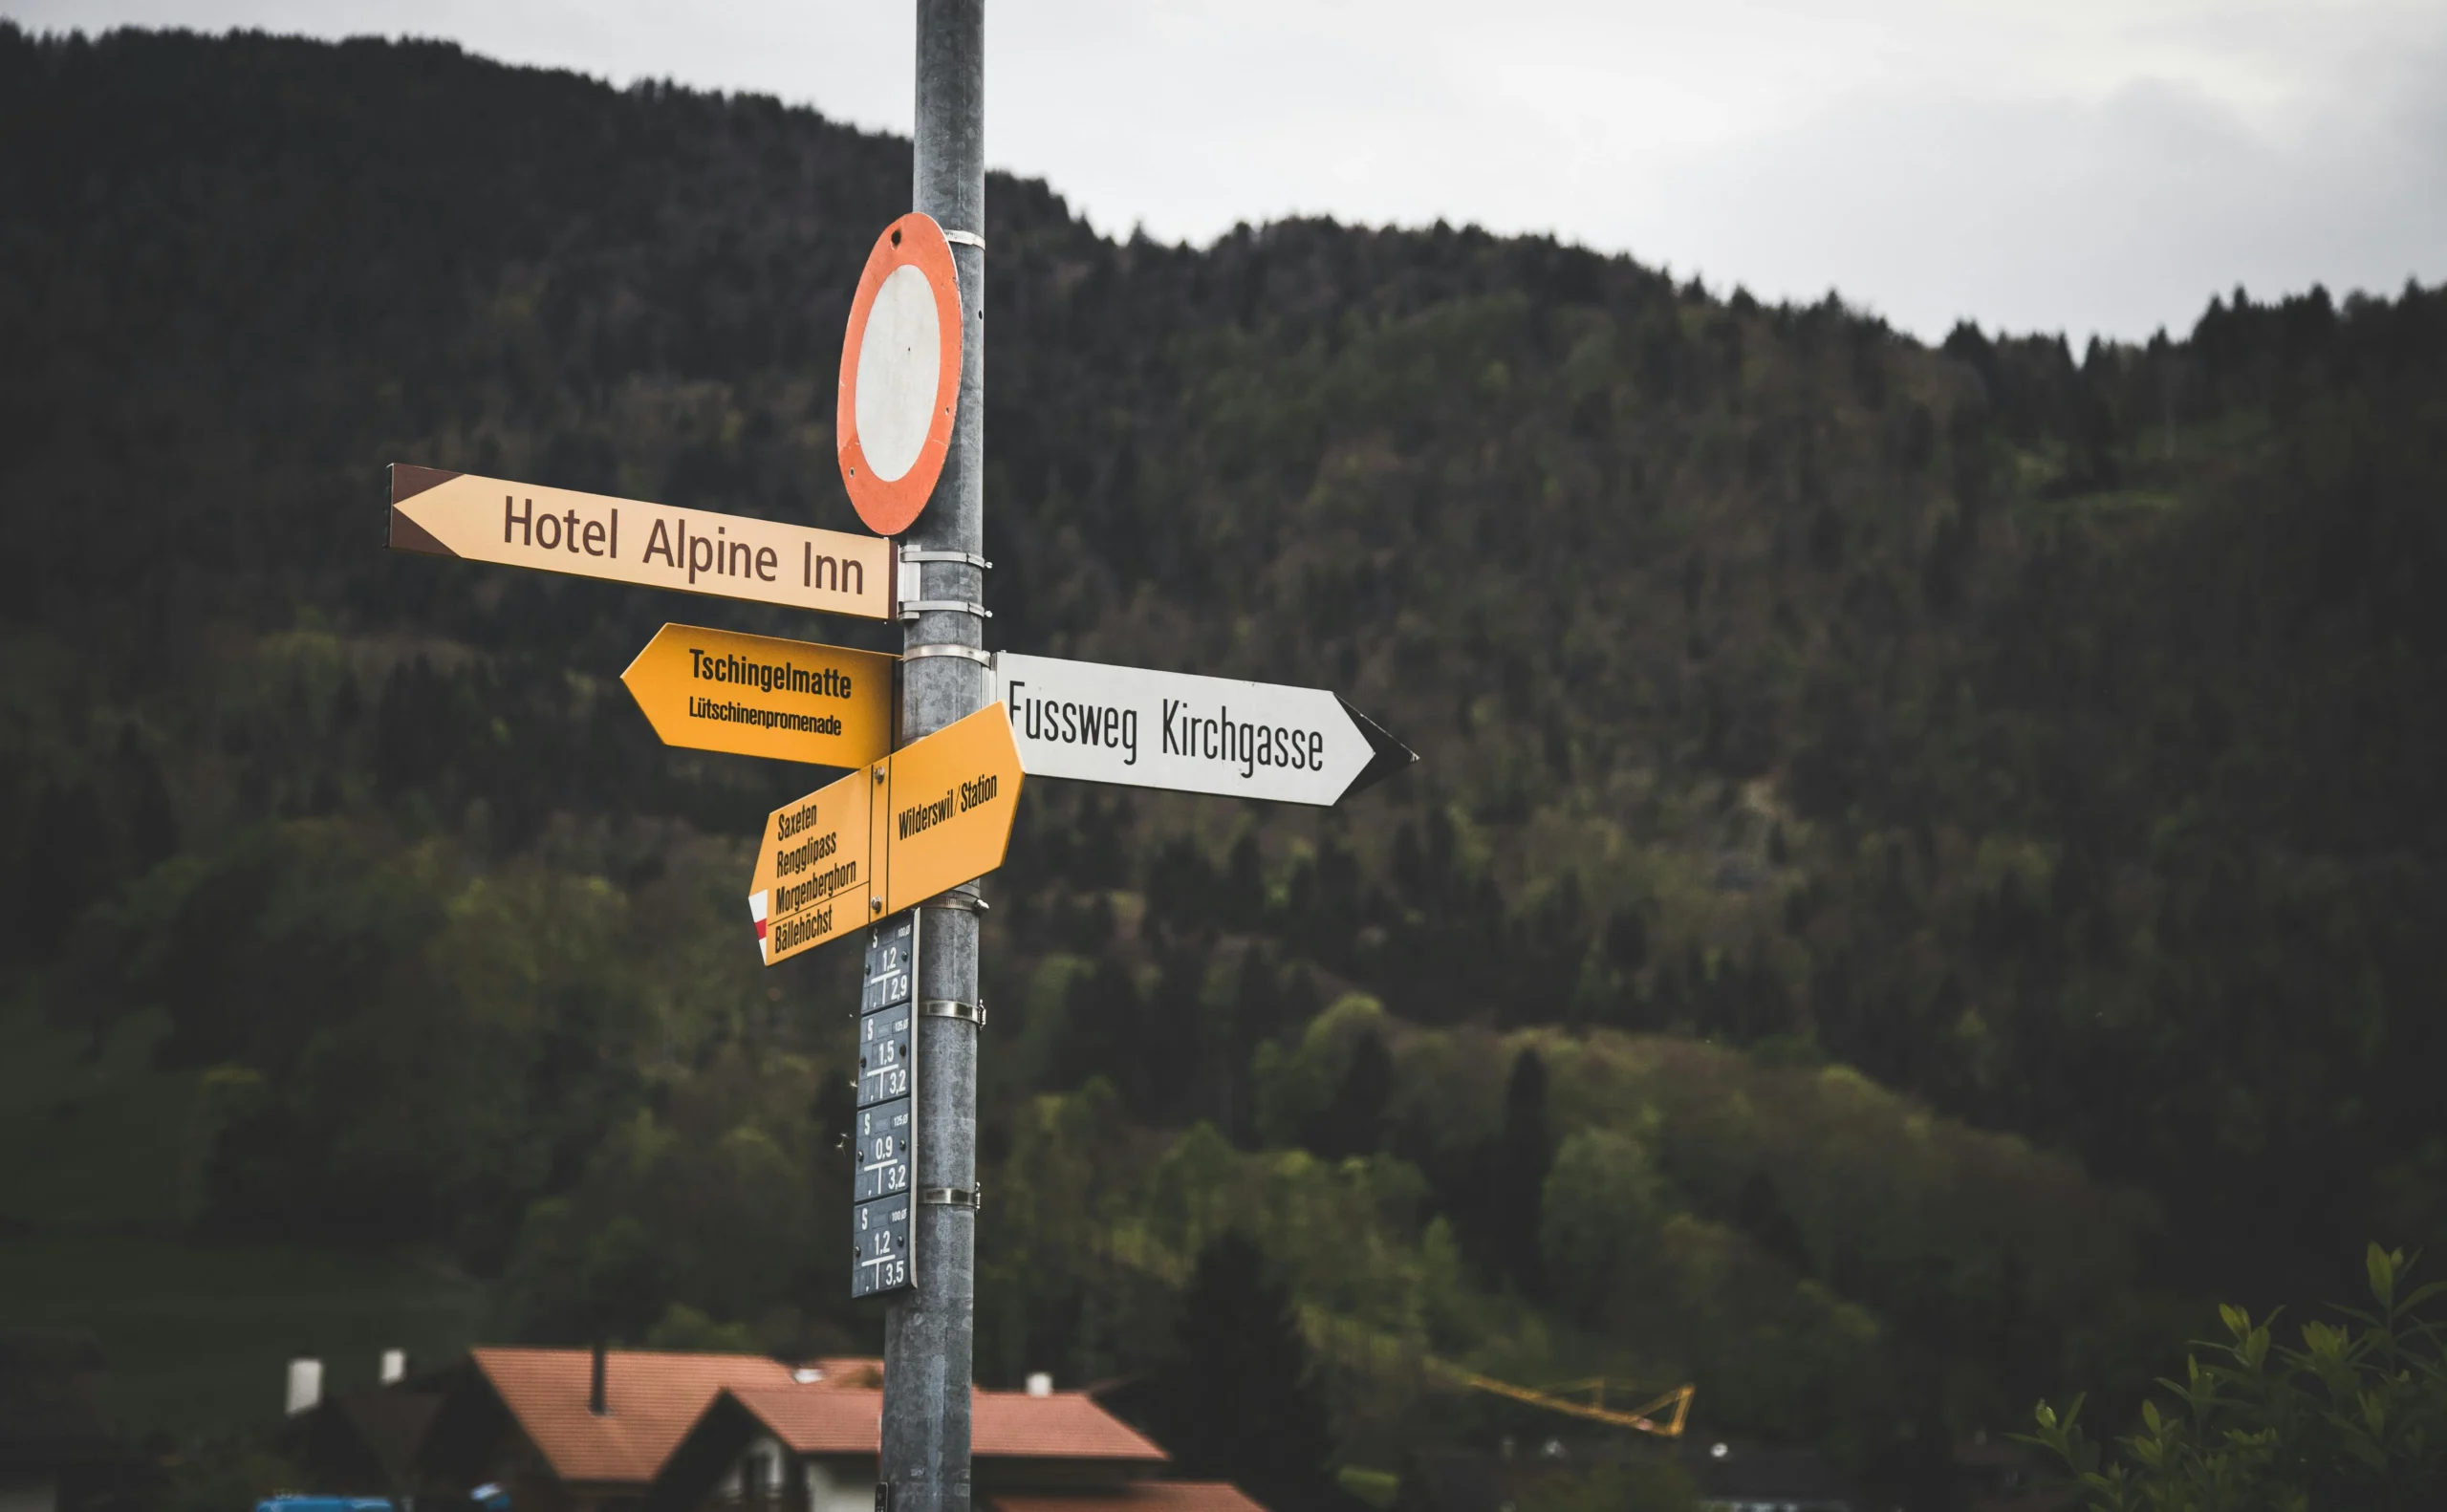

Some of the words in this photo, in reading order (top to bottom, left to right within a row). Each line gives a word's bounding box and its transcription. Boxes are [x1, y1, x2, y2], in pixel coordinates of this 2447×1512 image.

[504, 495, 618, 558] Hotel
[642, 517, 778, 585] Alpine
[803, 541, 863, 594] Inn
[689, 648, 852, 700] Tschingelmatte
[689, 696, 842, 736] Lütschinenpromenade
[1008, 680, 1137, 766] Fussweg
[1162, 698, 1324, 778] Kirchgasse
[777, 804, 817, 842] Saxeten
[776, 832, 837, 878] Rengglipass
[775, 860, 857, 917] Morgenberghorn
[774, 907, 833, 955] Bällehöchst
[872, 928, 878, 949] S
[890, 975, 907, 1001] 2,9
[867, 1019, 874, 1041] S
[889, 1069, 906, 1094] 3,2
[864, 1112, 871, 1135] S
[888, 1164, 906, 1190] 3,2
[861, 1208, 868, 1230] S
[885, 1260, 904, 1285] 3,5
